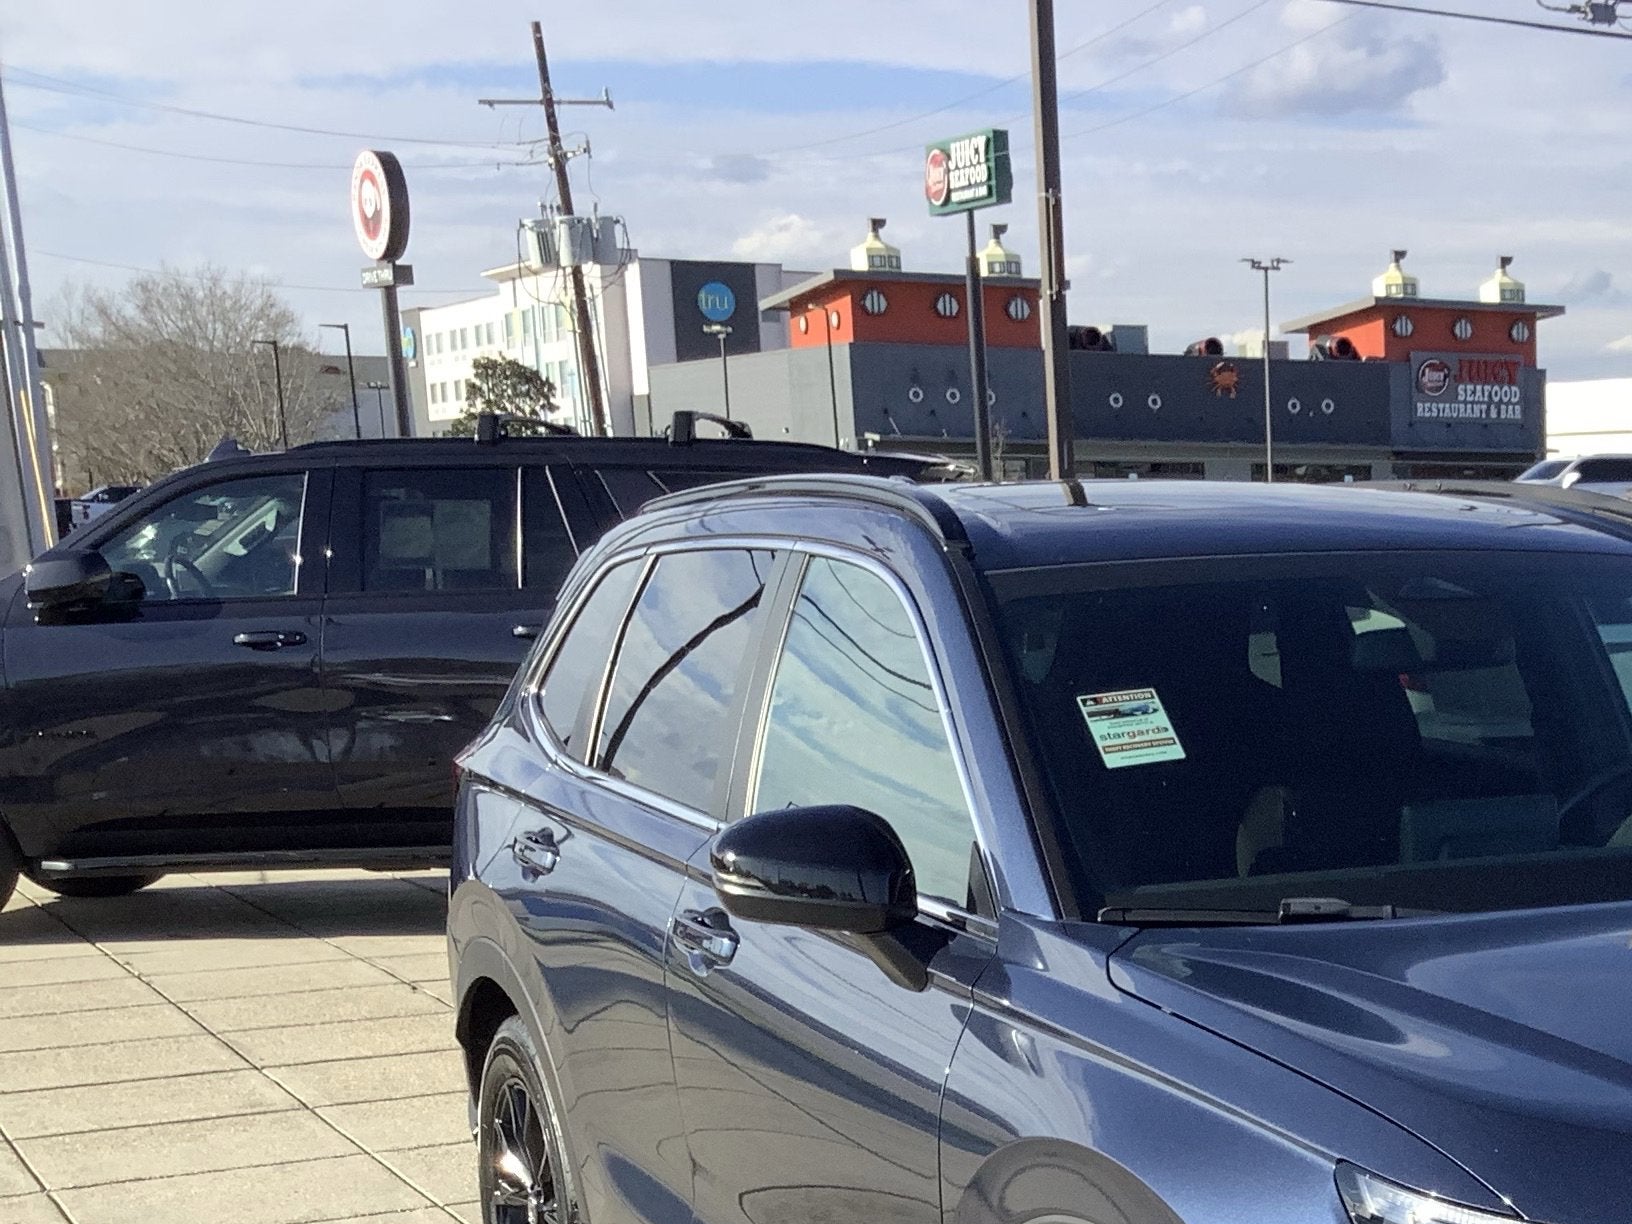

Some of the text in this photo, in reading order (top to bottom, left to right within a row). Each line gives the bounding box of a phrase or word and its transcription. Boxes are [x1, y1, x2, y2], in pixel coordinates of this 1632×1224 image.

[948, 135, 987, 170] JUICY
[949, 163, 988, 189] SEAFOOD
[700, 289, 729, 311] tru
[1455, 359, 1521, 385] JUICY
[1457, 384, 1520, 403] SEAFOOD
[1416, 402, 1522, 419] RESTAURANT & BAR
[1102, 691, 1152, 704] ATTENTION
